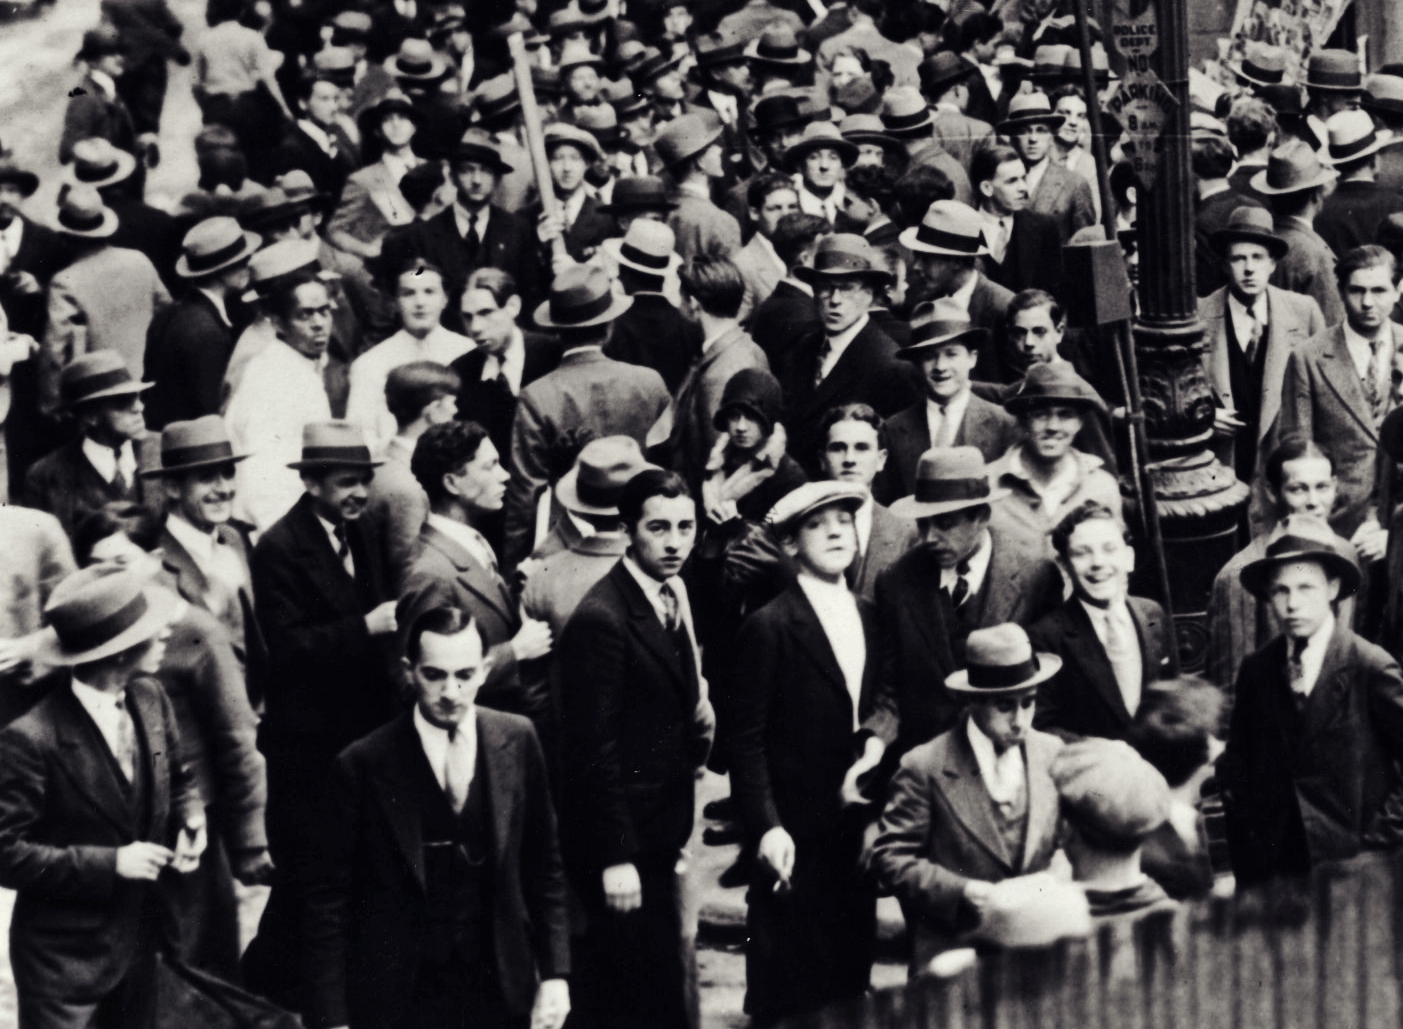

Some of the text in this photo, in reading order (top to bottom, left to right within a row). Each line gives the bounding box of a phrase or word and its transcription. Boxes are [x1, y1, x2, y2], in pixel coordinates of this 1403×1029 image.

[1113, 25, 1156, 35] POLICE
[1128, 55, 1148, 73] NO
[1110, 83, 1174, 114] PARKING
